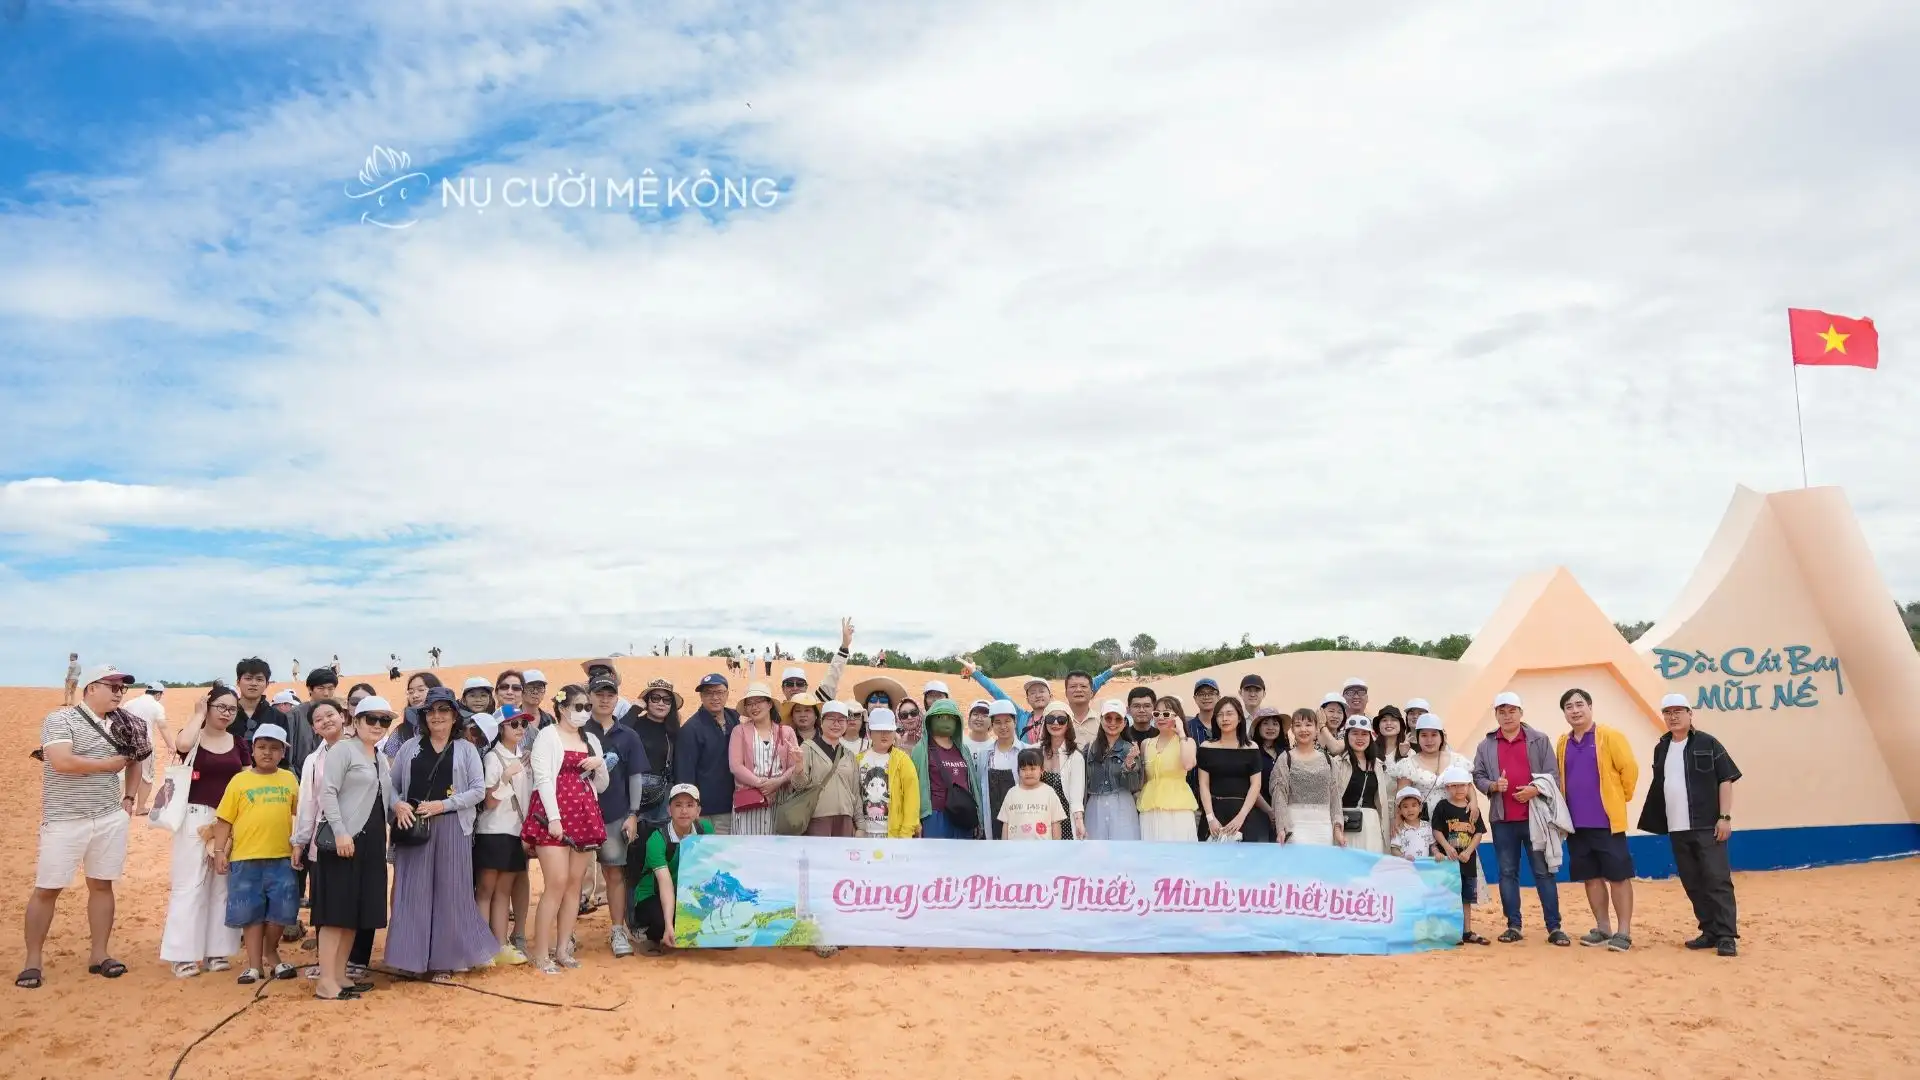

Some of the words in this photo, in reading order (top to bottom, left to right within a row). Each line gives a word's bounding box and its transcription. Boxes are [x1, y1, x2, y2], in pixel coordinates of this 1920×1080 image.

[1652, 648, 1718, 679] Đồi
[1720, 648, 1782, 677] Cát
[1783, 645, 1844, 695] Bay
[1692, 680, 1762, 712] MŨI
[1769, 676, 1819, 711] NÉ
[832, 879, 919, 920] Cùng
[922, 876, 963, 910] đi
[963, 874, 1053, 910] Phan
[1153, 878, 1236, 913] Mình
[1238, 883, 1282, 914] vui
[1285, 882, 1327, 918] hết
